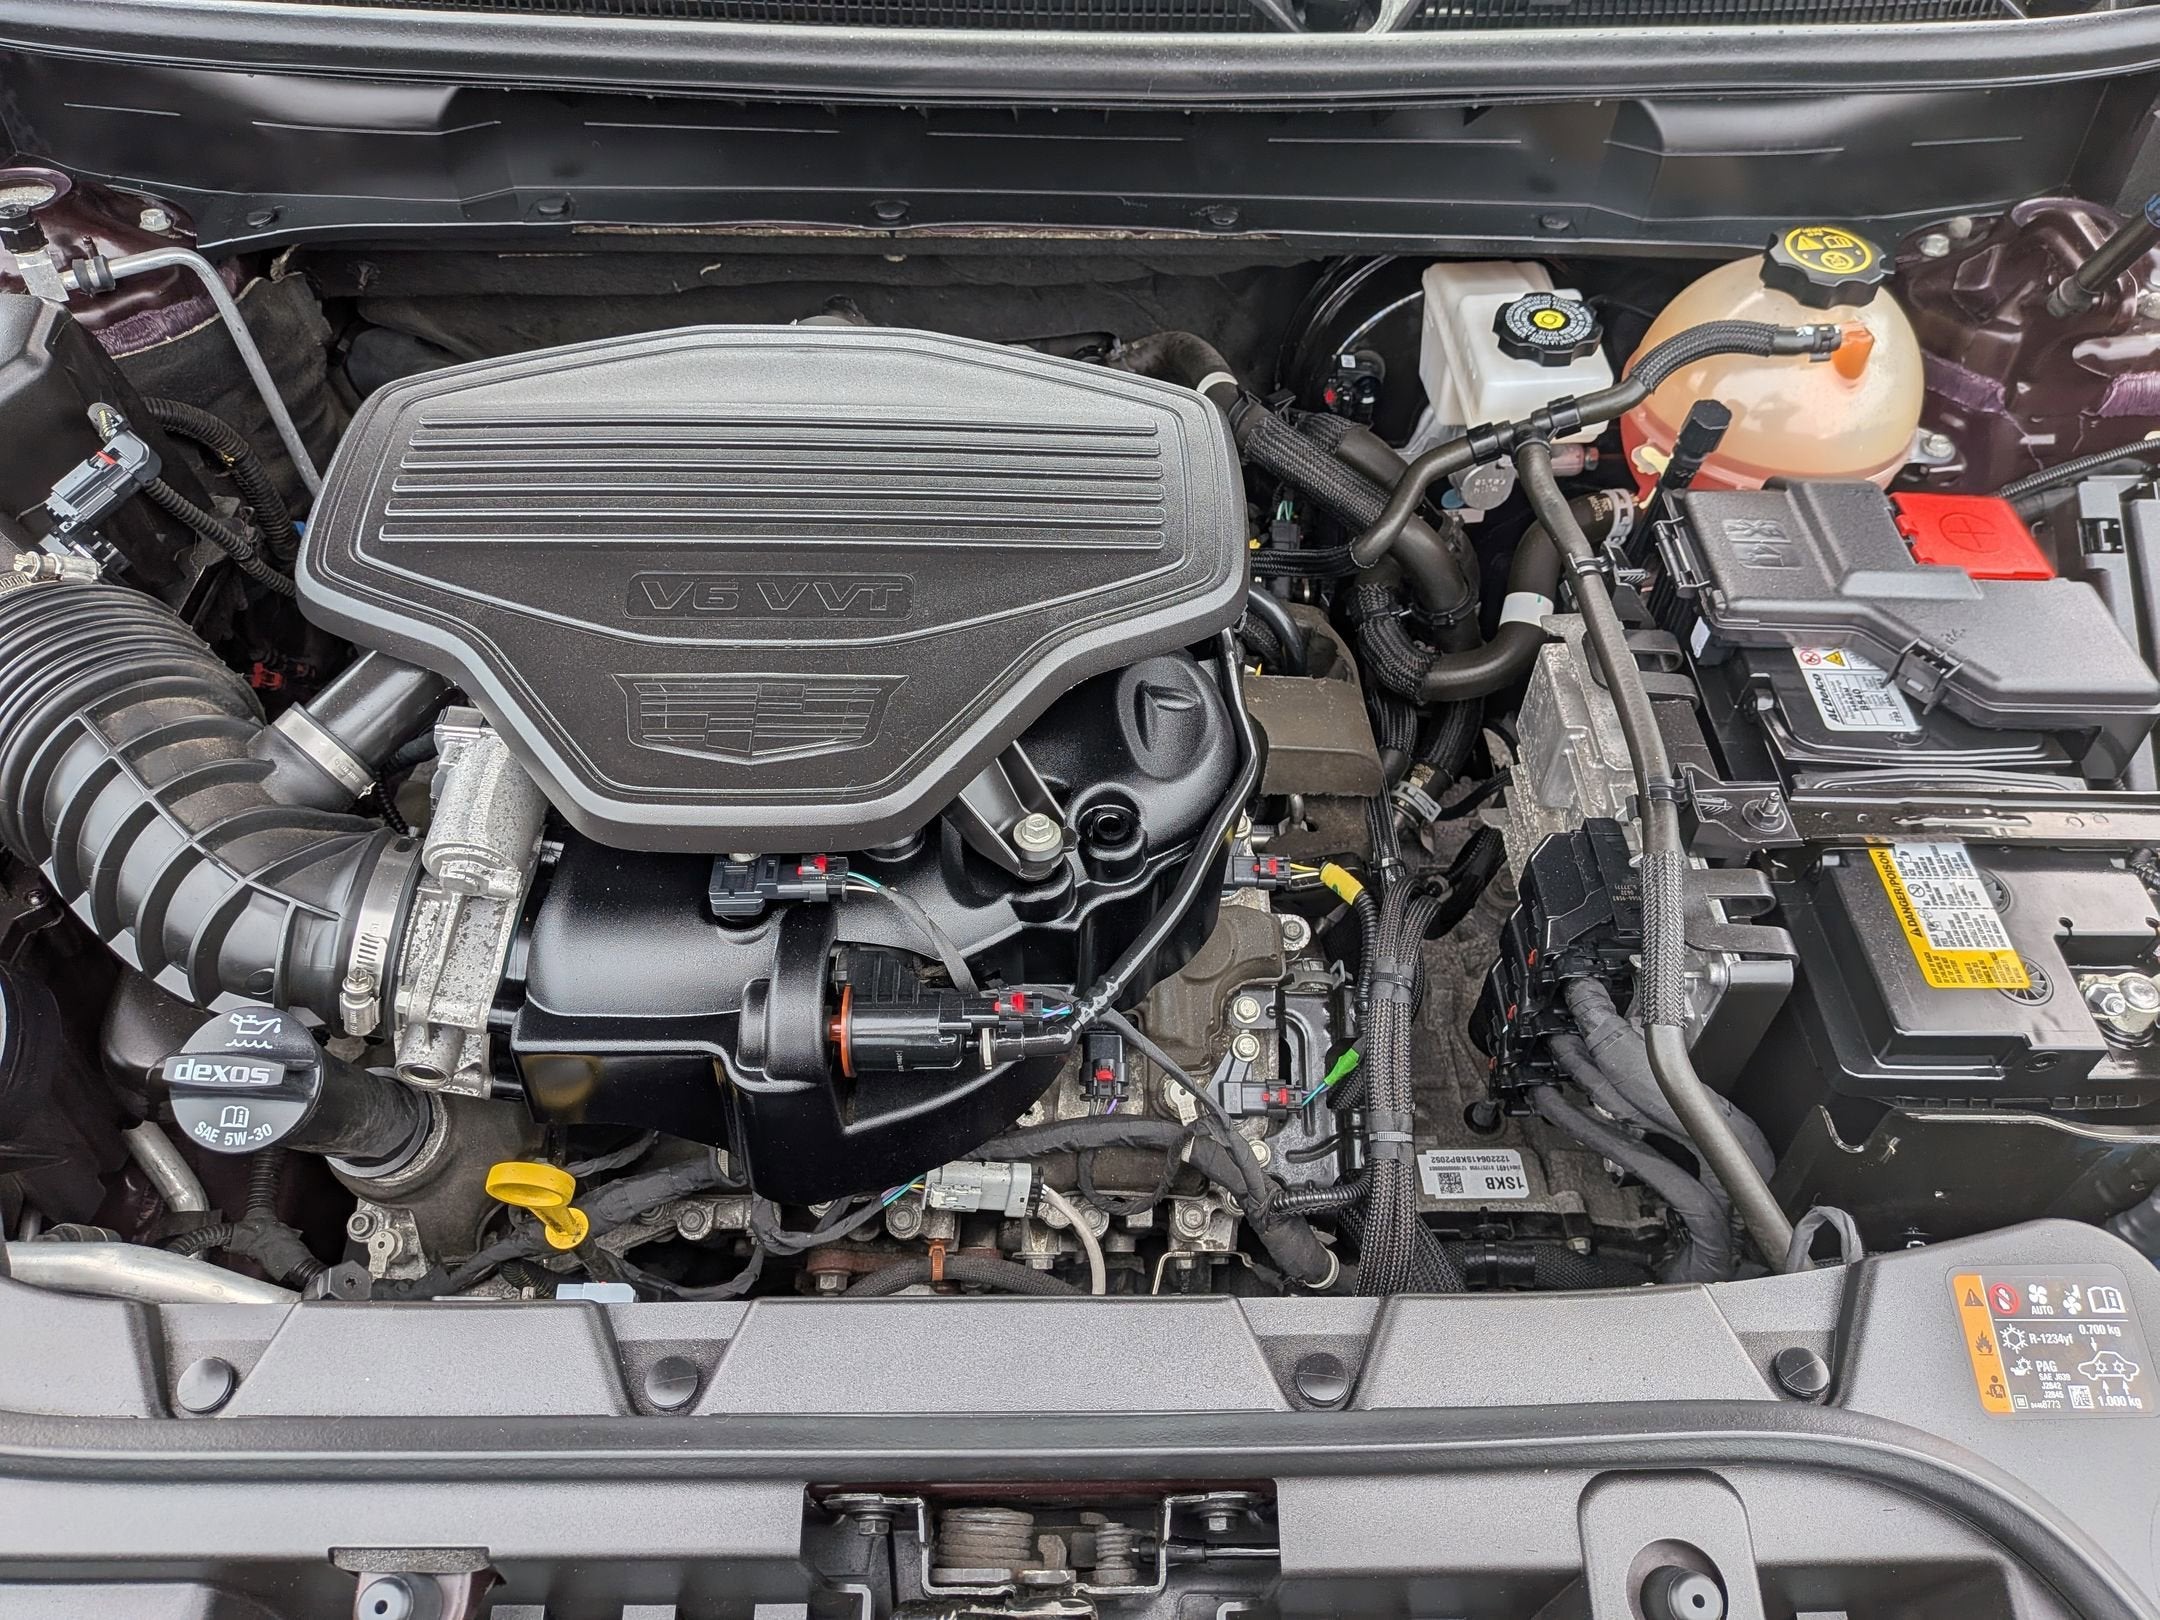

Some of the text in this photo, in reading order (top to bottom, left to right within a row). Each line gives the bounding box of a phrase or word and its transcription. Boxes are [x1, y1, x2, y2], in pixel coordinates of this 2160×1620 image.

[641, 581, 904, 611] V6 VVT
[1812, 673, 1841, 723] ACDelco
[1875, 851, 1918, 926] DANGER/POISON
[174, 1059, 271, 1084] dexos
[194, 1121, 273, 1146] SAE 5W-30
[1485, 1176, 1524, 1190] 1SKB
[2031, 1305, 2054, 1315] AUTO
[2078, 1324, 2122, 1337] 0.700 kg
[2028, 1333, 2074, 1346] R-1234yf
[2036, 1360, 2058, 1372] PAG
[2038, 1373, 2053, 1381] SAE
[2097, 1395, 2142, 1409] 1.000 kg
